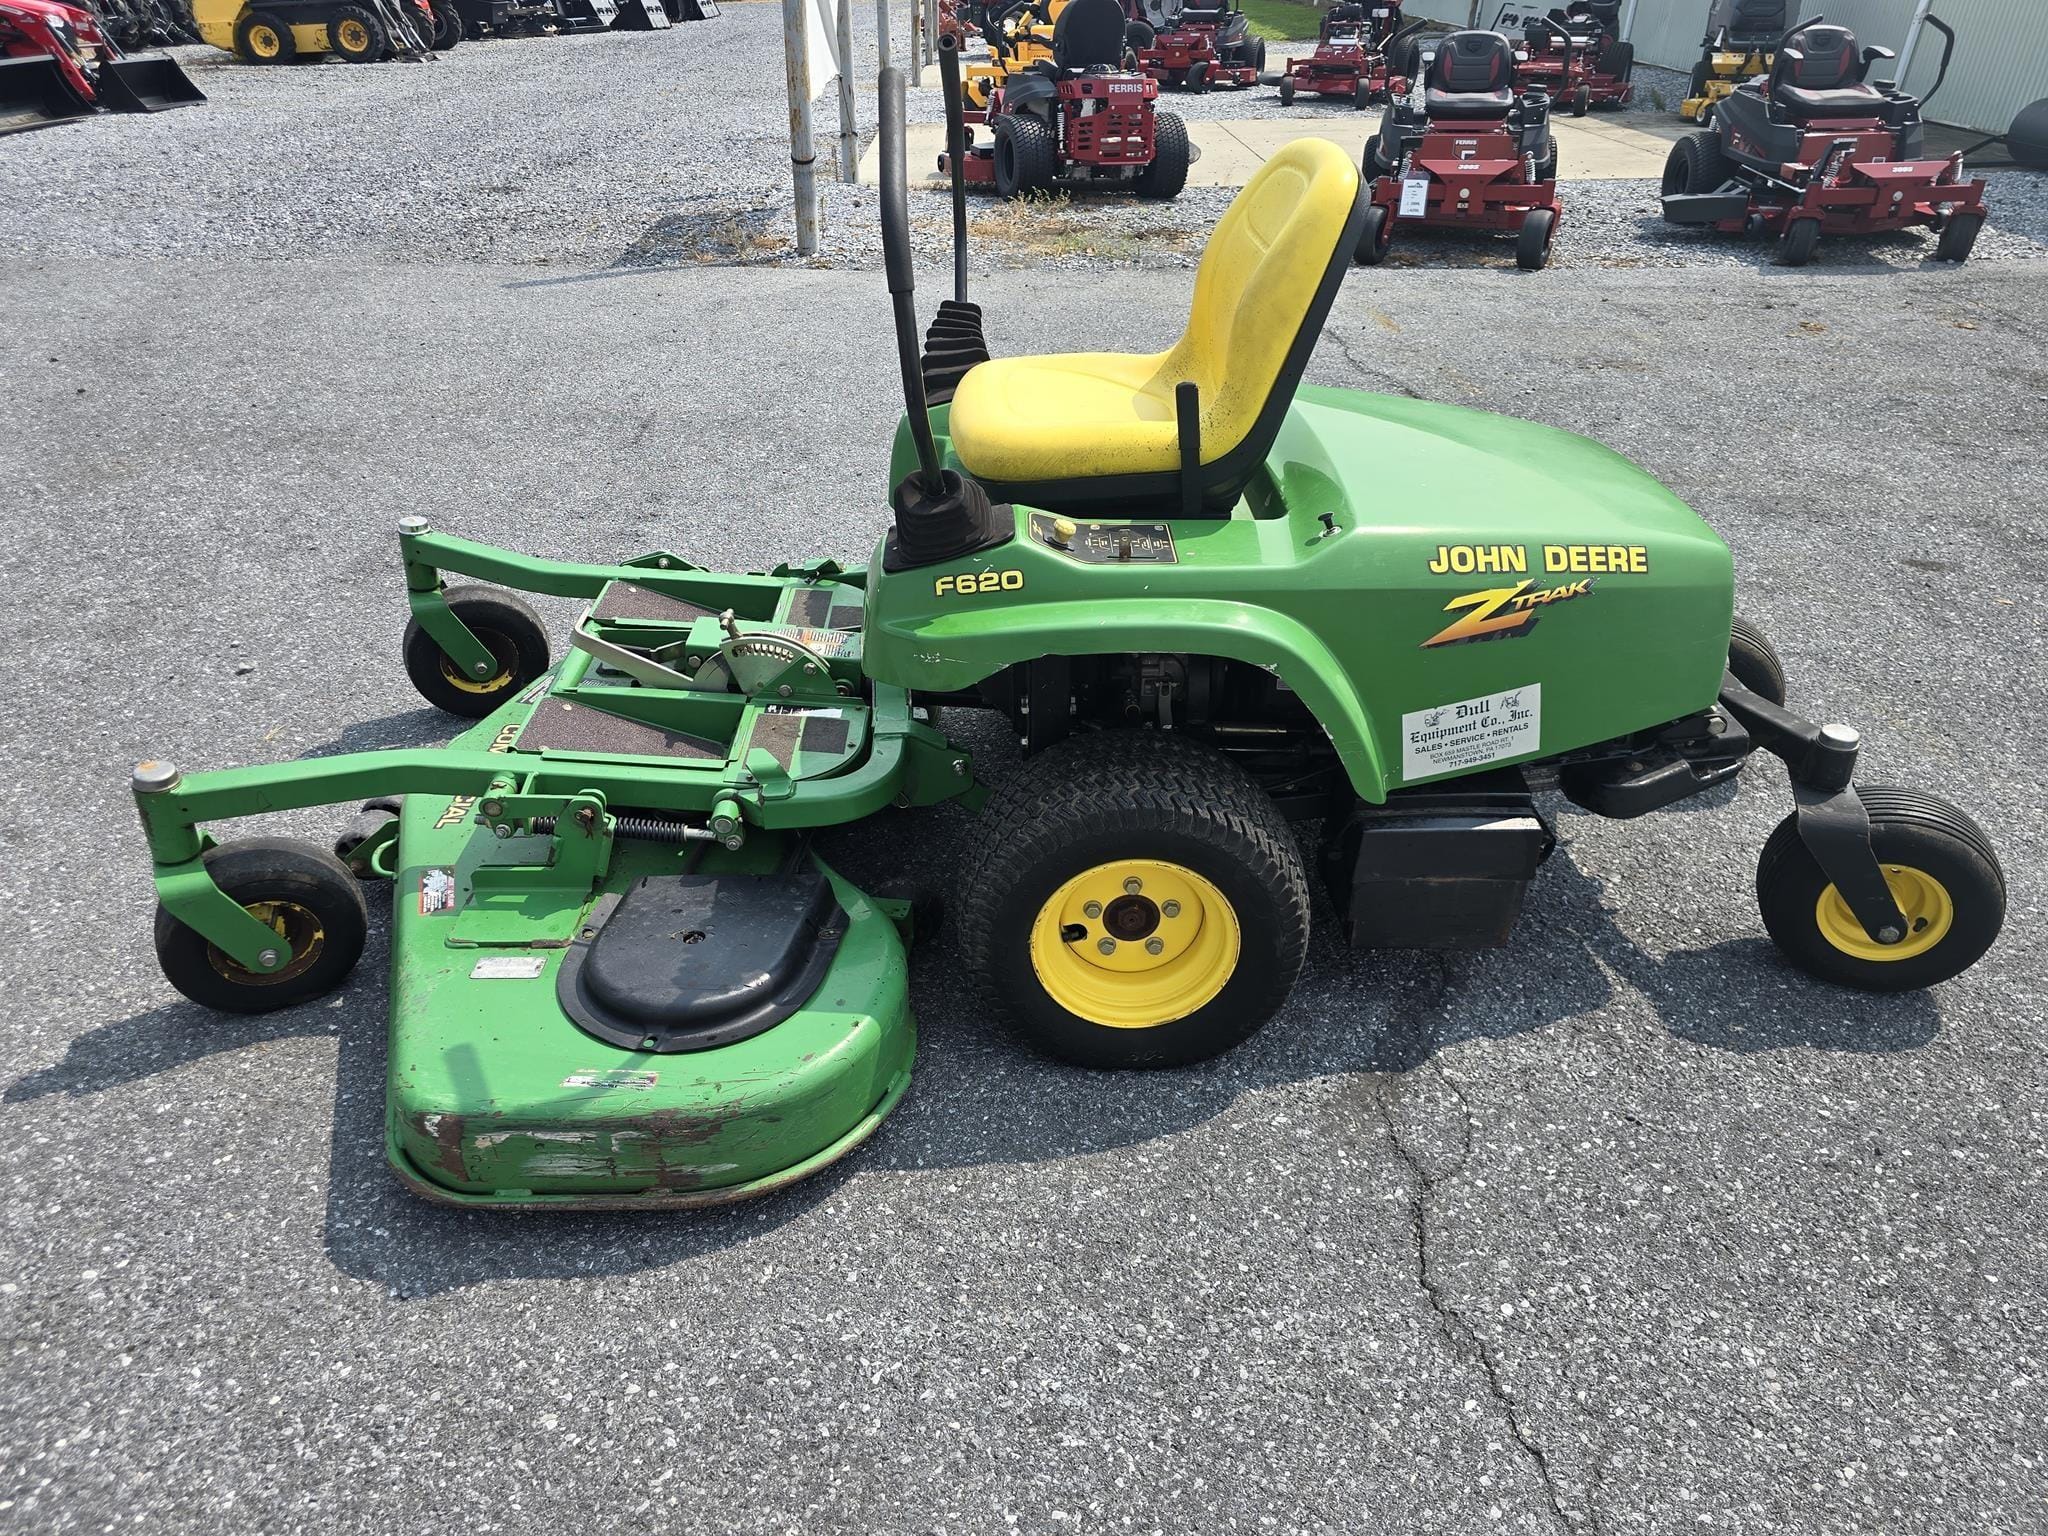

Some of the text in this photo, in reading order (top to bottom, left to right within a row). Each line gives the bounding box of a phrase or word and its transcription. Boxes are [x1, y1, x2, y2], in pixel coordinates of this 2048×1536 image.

[1108, 83, 1143, 93] FERRIS
[1429, 545, 1649, 574] JOHN DEERE
[935, 569, 1025, 597] F620
[1511, 577, 1594, 610] TRAK
[1455, 699, 1490, 719] Dull
[1410, 720, 1477, 744] Equipment
[1508, 709, 1533, 722] Inc.
[1415, 722, 1529, 755] SALES SERVICE RENTALS
